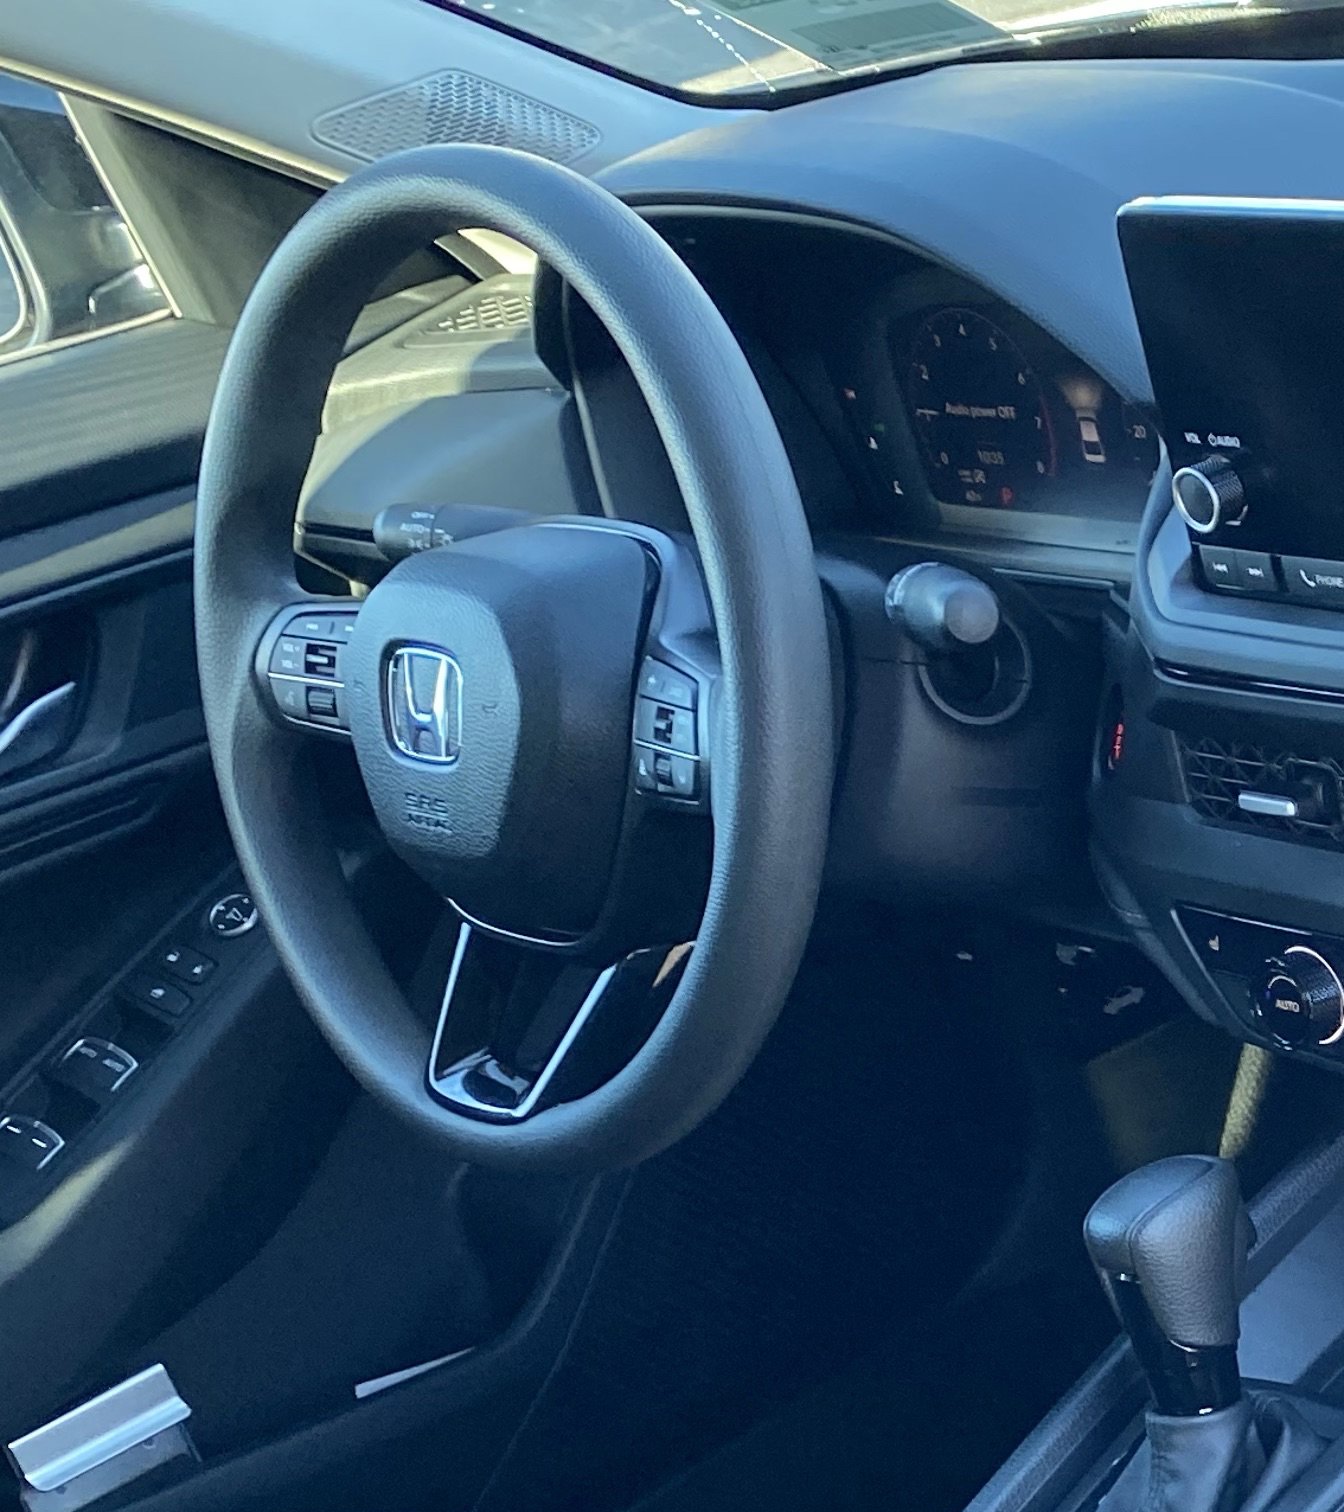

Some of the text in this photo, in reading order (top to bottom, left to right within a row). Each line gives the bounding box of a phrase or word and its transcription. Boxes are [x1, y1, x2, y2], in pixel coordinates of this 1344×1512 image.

[1184, 432, 1240, 448] VOL AUDIO
[1315, 575, 1344, 588] PHONE
[1275, 999, 1300, 1013] AUTO
